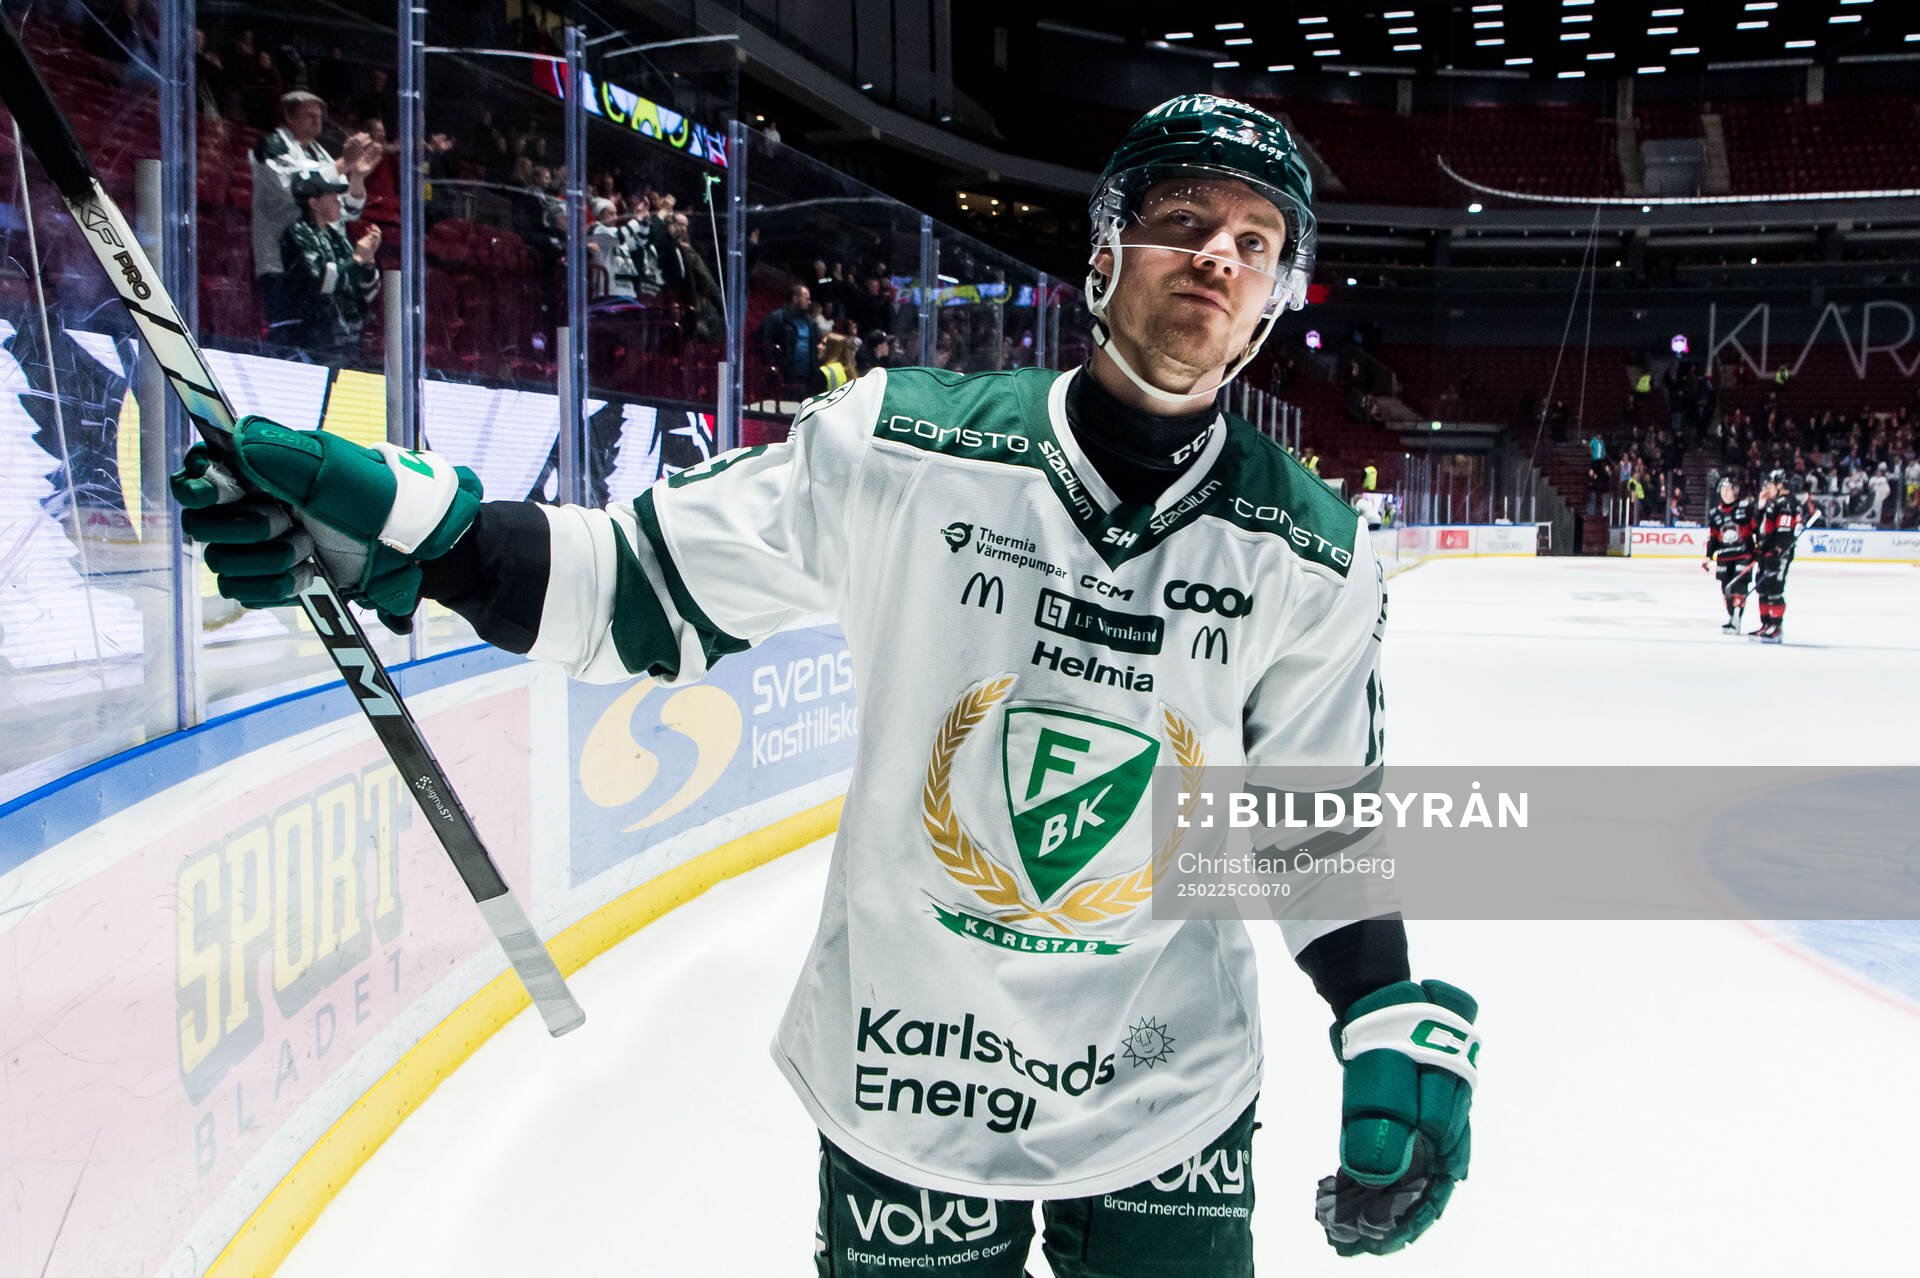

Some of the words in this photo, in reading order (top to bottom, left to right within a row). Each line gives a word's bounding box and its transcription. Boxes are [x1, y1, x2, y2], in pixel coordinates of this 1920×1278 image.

[1252, 140, 1287, 160] 1698
[113, 251, 152, 300] PRO
[1707, 301, 1920, 380] KLAR
[1170, 424, 1216, 465] CC
[976, 541, 1068, 579] Värmepumpar
[979, 526, 1037, 553] Thermia
[1079, 574, 1135, 602] CCM
[1075, 613, 1093, 628] LF
[300, 576, 402, 716] CM
[1031, 640, 1154, 693] Helmia
[752, 650, 857, 716] svens
[1024, 727, 1091, 802] F
[1038, 783, 1114, 858] BK
[177, 760, 408, 1088] SPORT
[964, 918, 1099, 954] KARLSTAD
[195, 947, 403, 1181] BLADET
[857, 1006, 1116, 1097] Karlstads
[855, 1063, 1037, 1133] Energi
[1150, 1150, 1245, 1195] oky
[1104, 1194, 1147, 1214] Brand
[1150, 1202, 1195, 1217] merch
[1197, 1203, 1235, 1218] made
[847, 1248, 886, 1266] Brand
[889, 1250, 934, 1268] merch
[937, 1246, 979, 1265] made
[982, 1240, 1012, 1258] easy
